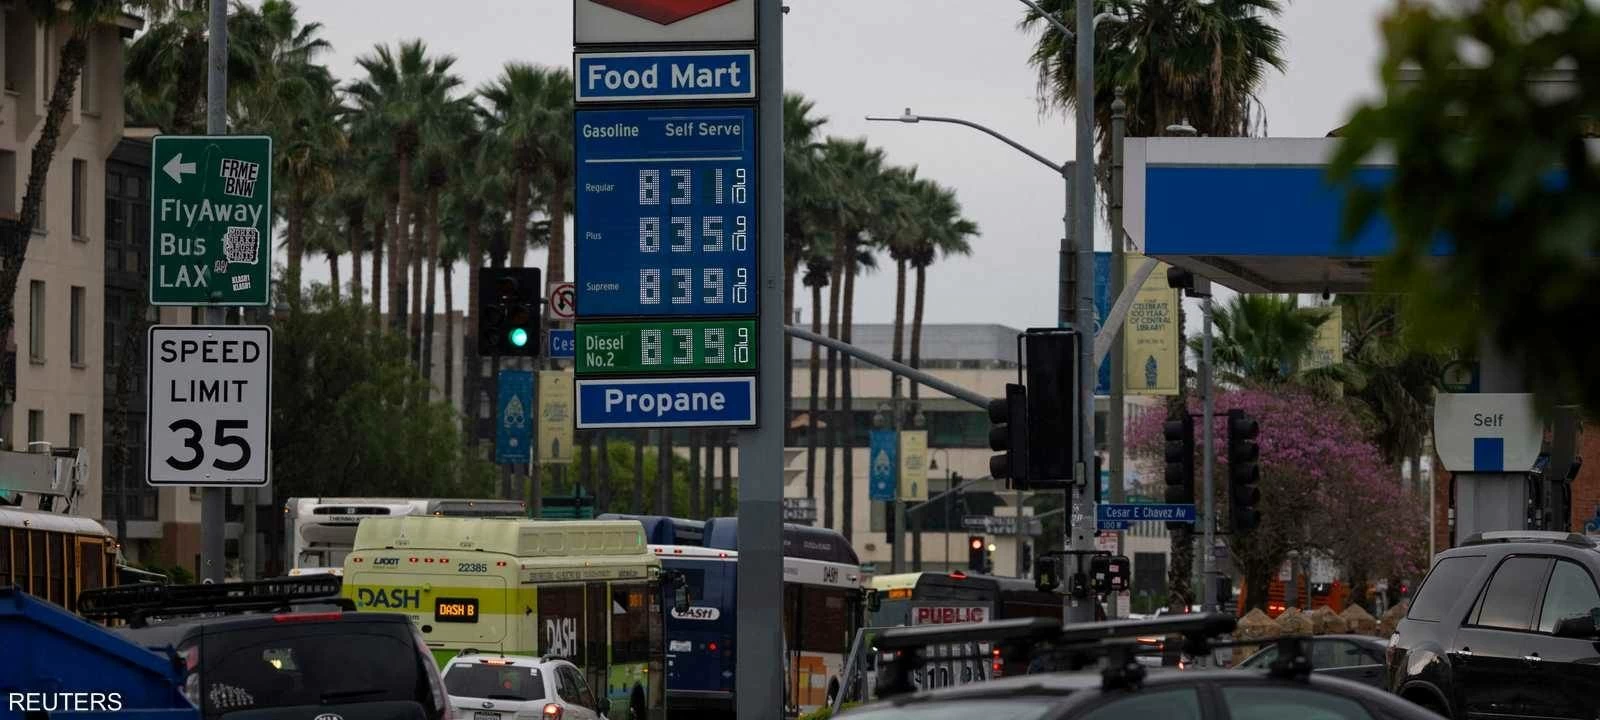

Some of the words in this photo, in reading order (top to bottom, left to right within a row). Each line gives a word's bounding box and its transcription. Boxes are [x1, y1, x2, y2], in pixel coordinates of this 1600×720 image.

[588, 63, 658, 90] Food
[671, 61, 741, 89] Mart
[583, 123, 639, 138] Gasoline
[665, 122, 694, 137] Self
[698, 122, 741, 136] Serve
[221, 159, 258, 180] FRME
[225, 177, 255, 197] BNW
[585, 183, 615, 193] Regular
[639, 168, 723, 205] 831
[161, 199, 263, 228] FlyAway
[160, 232, 207, 256] Bus
[586, 231, 602, 240] Plus
[639, 216, 724, 252] 835
[159, 264, 208, 288] LAX
[639, 268, 724, 304] 839
[586, 282, 620, 292] Supreme
[160, 340, 260, 363] SPEED
[586, 335, 624, 351] Diesel
[640, 327, 725, 365] 839
[586, 352, 614, 367] No.2
[170, 379, 248, 403] LIMIT
[604, 388, 726, 417] Propane
[1473, 413, 1504, 427] Self
[165, 418, 251, 471] 35
[1106, 507, 1130, 518] Cesar
[1134, 507, 1140, 518] E
[1143, 506, 1173, 518] Chavez
[1175, 507, 1186, 518] Av
[1103, 521, 1115, 529] 100
[458, 563, 488, 573] 22385
[357, 588, 420, 609] DASH
[439, 604, 465, 616] DASH
[467, 605, 474, 616] B
[918, 607, 984, 624] PUBLIC
[546, 618, 577, 658] DASH
